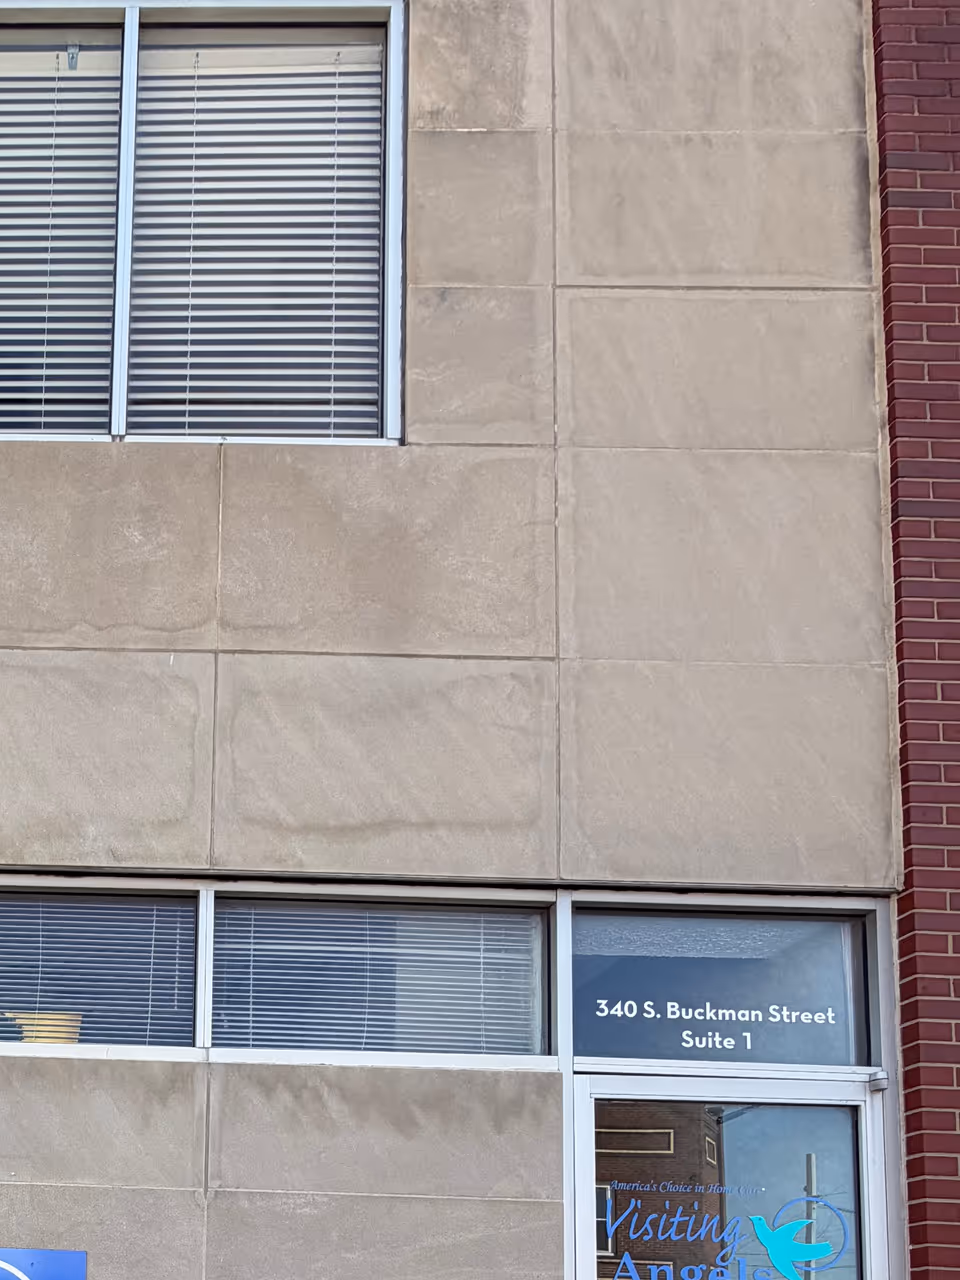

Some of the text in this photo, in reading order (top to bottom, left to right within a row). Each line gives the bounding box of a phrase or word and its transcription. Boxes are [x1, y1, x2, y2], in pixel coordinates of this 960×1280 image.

[595, 999, 836, 1024] 340 S. Buckman Street
[681, 1030, 752, 1050] Suite 1
[659, 1181, 692, 1193] Choice
[695, 1182, 705, 1193] in
[707, 1182, 736, 1194] Hom
[606, 1197, 749, 1267] Visiting
